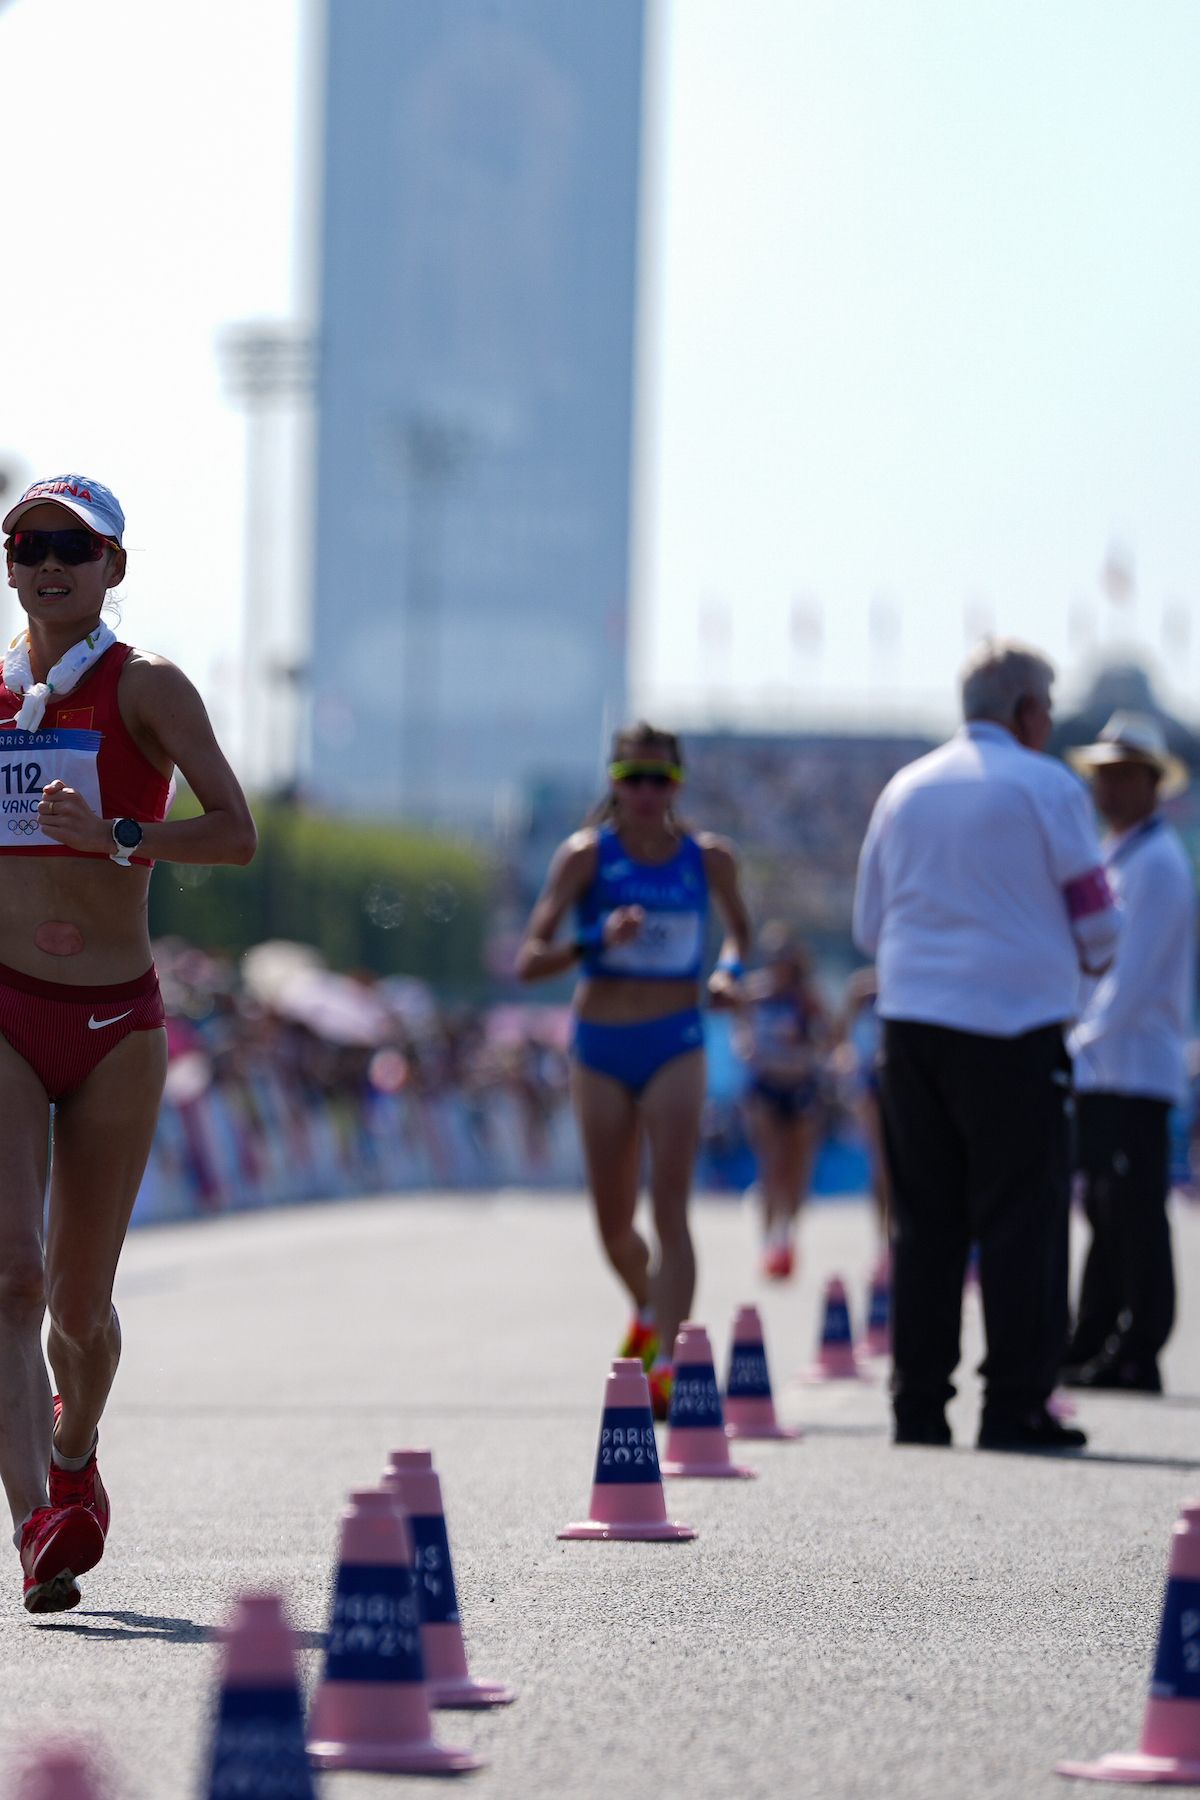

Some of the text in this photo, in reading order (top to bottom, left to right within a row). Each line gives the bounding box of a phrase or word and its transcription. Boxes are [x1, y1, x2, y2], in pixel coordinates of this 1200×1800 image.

[25, 481, 93, 503] CHINA
[28, 734, 59, 745] 2024
[1, 762, 44, 794] 112
[602, 1427, 655, 1446] PARIS
[602, 1446, 656, 1465] 2024
